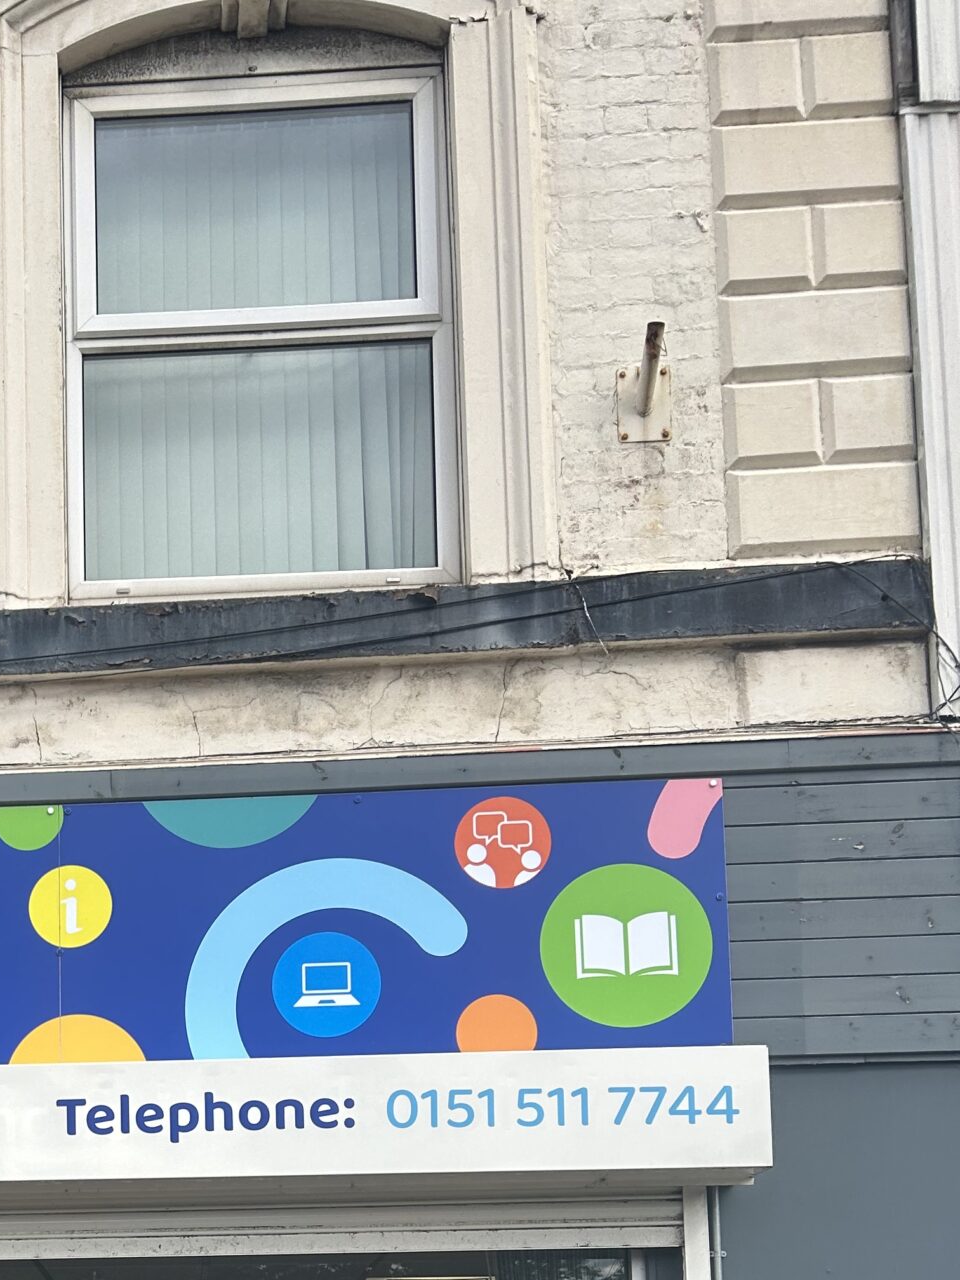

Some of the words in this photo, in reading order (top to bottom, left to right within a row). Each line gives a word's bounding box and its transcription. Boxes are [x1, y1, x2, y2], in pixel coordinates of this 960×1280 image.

[56, 1092, 356, 1144] Telephone:
[386, 1088, 496, 1129] 0151
[517, 1087, 590, 1128] 511
[607, 1084, 740, 1126] 7744
